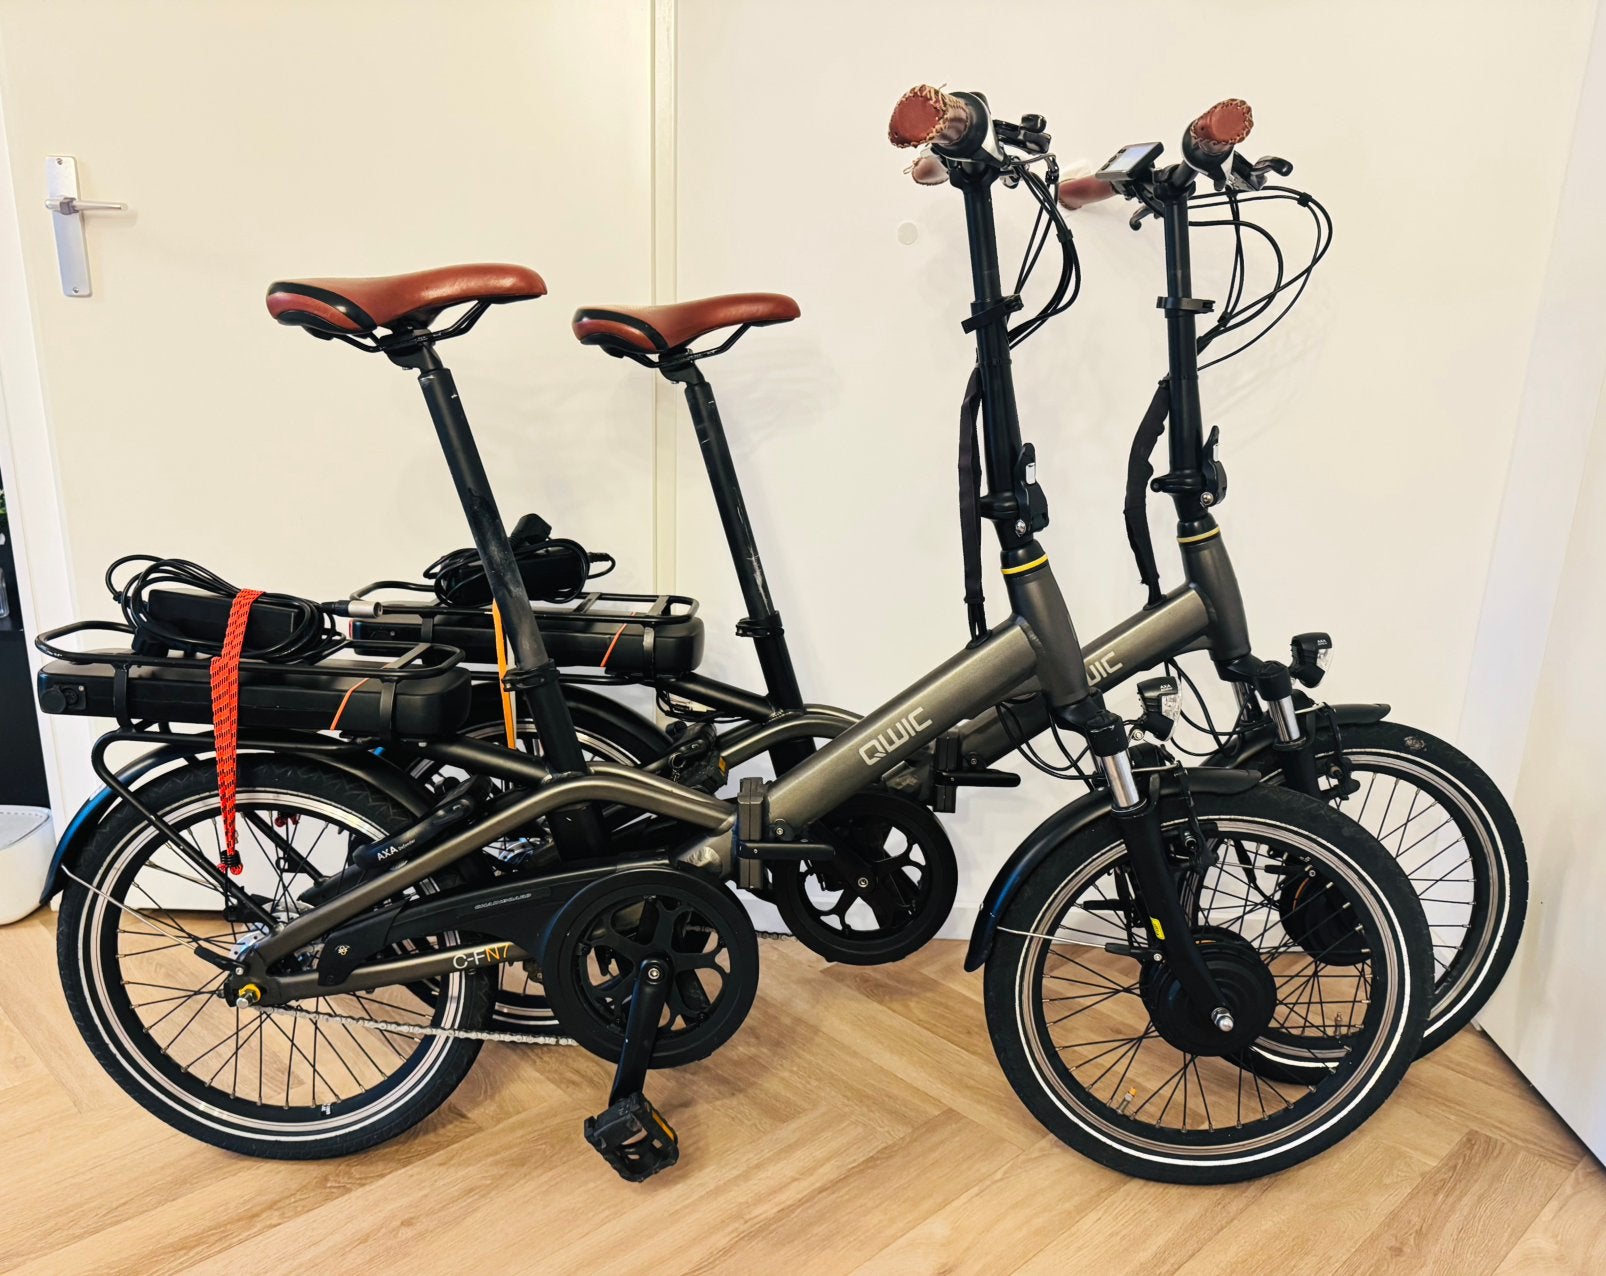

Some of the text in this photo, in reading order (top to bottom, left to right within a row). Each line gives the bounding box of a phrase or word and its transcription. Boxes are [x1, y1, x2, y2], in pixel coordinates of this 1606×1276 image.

[1086, 651, 1123, 687] IC
[858, 706, 933, 766] QWIC
[377, 845, 399, 861] AXA
[453, 944, 511, 969] C-FN7
